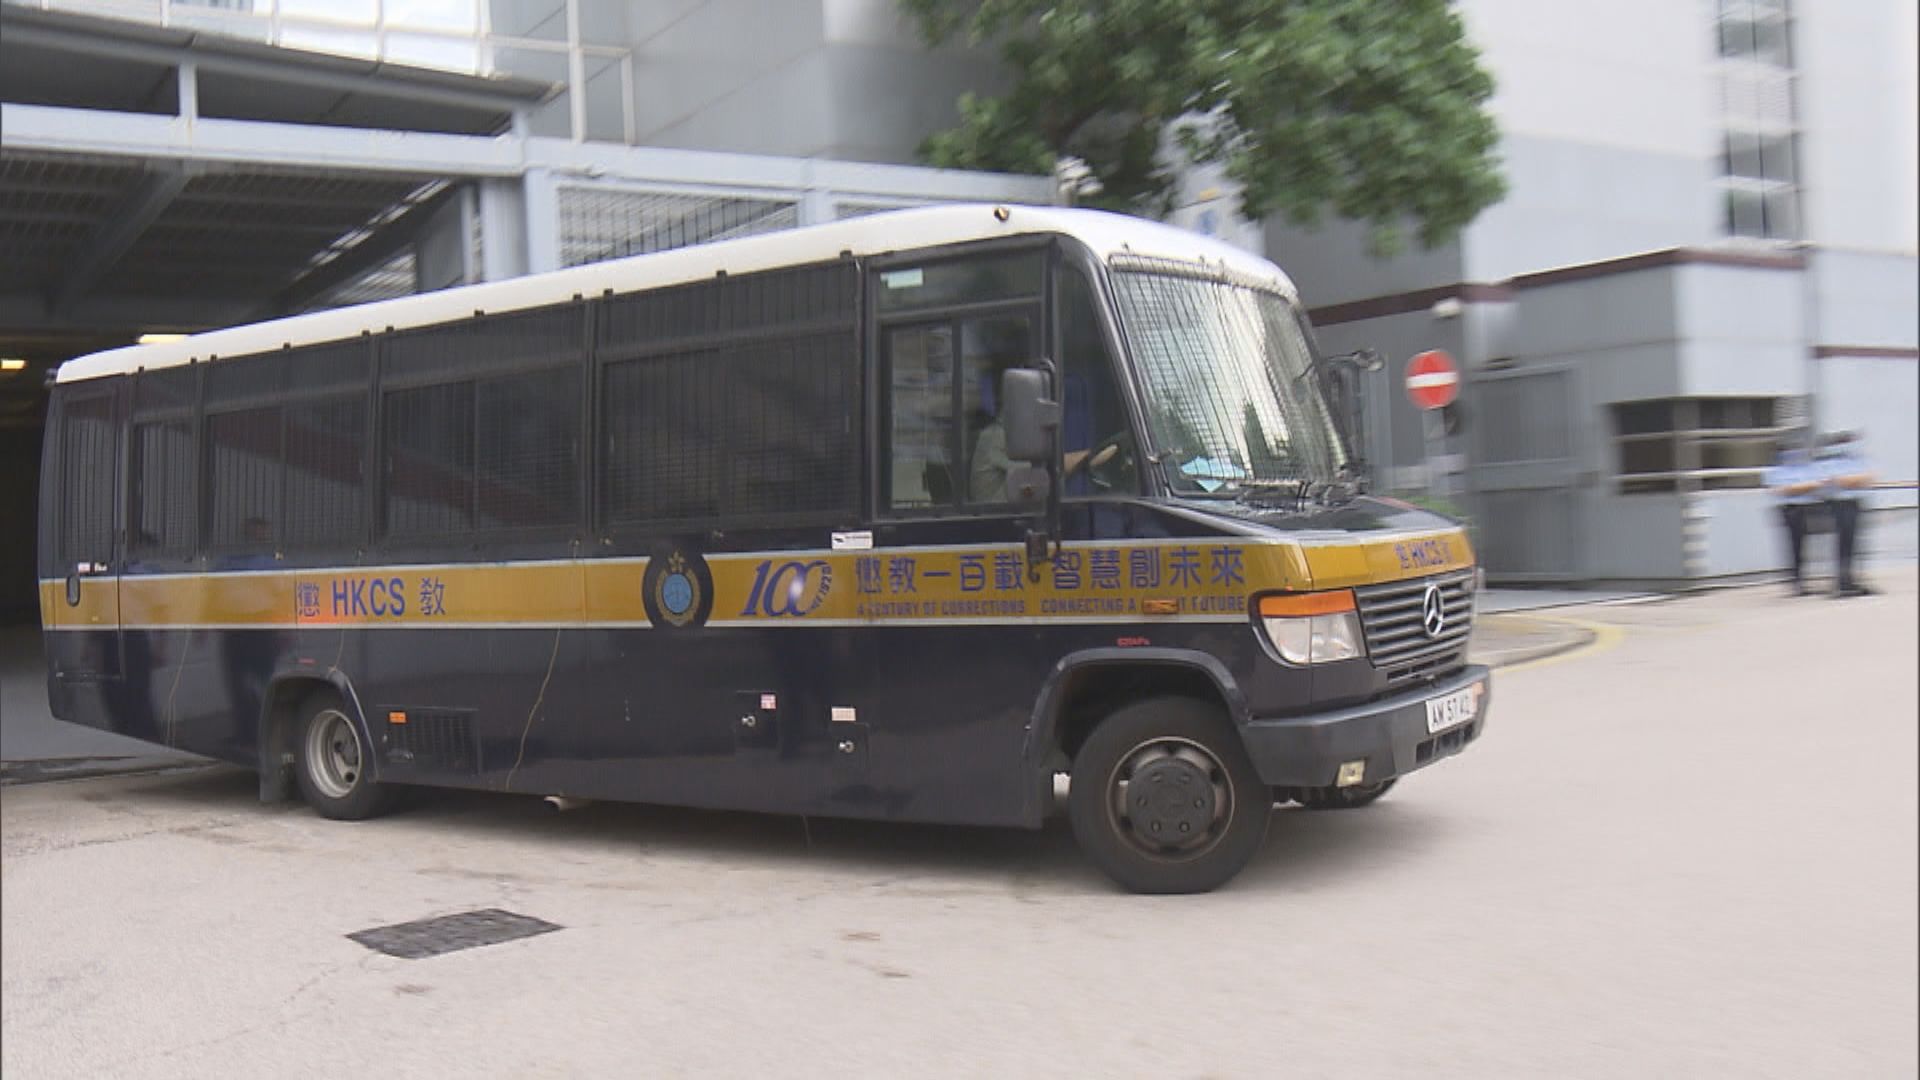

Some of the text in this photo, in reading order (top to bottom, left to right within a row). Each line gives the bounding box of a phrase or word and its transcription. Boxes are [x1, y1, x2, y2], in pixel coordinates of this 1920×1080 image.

[855, 545, 1246, 593] 懲教一百載 智慧創未來
[332, 577, 406, 617] HKCS
[923, 601, 936, 615] OF
[941, 600, 1025, 615] CORRECTIONS
[1040, 598, 1124, 613] CONNECTING
[1128, 598, 1137, 611] A
[1191, 596, 1245, 611] FUTURE
